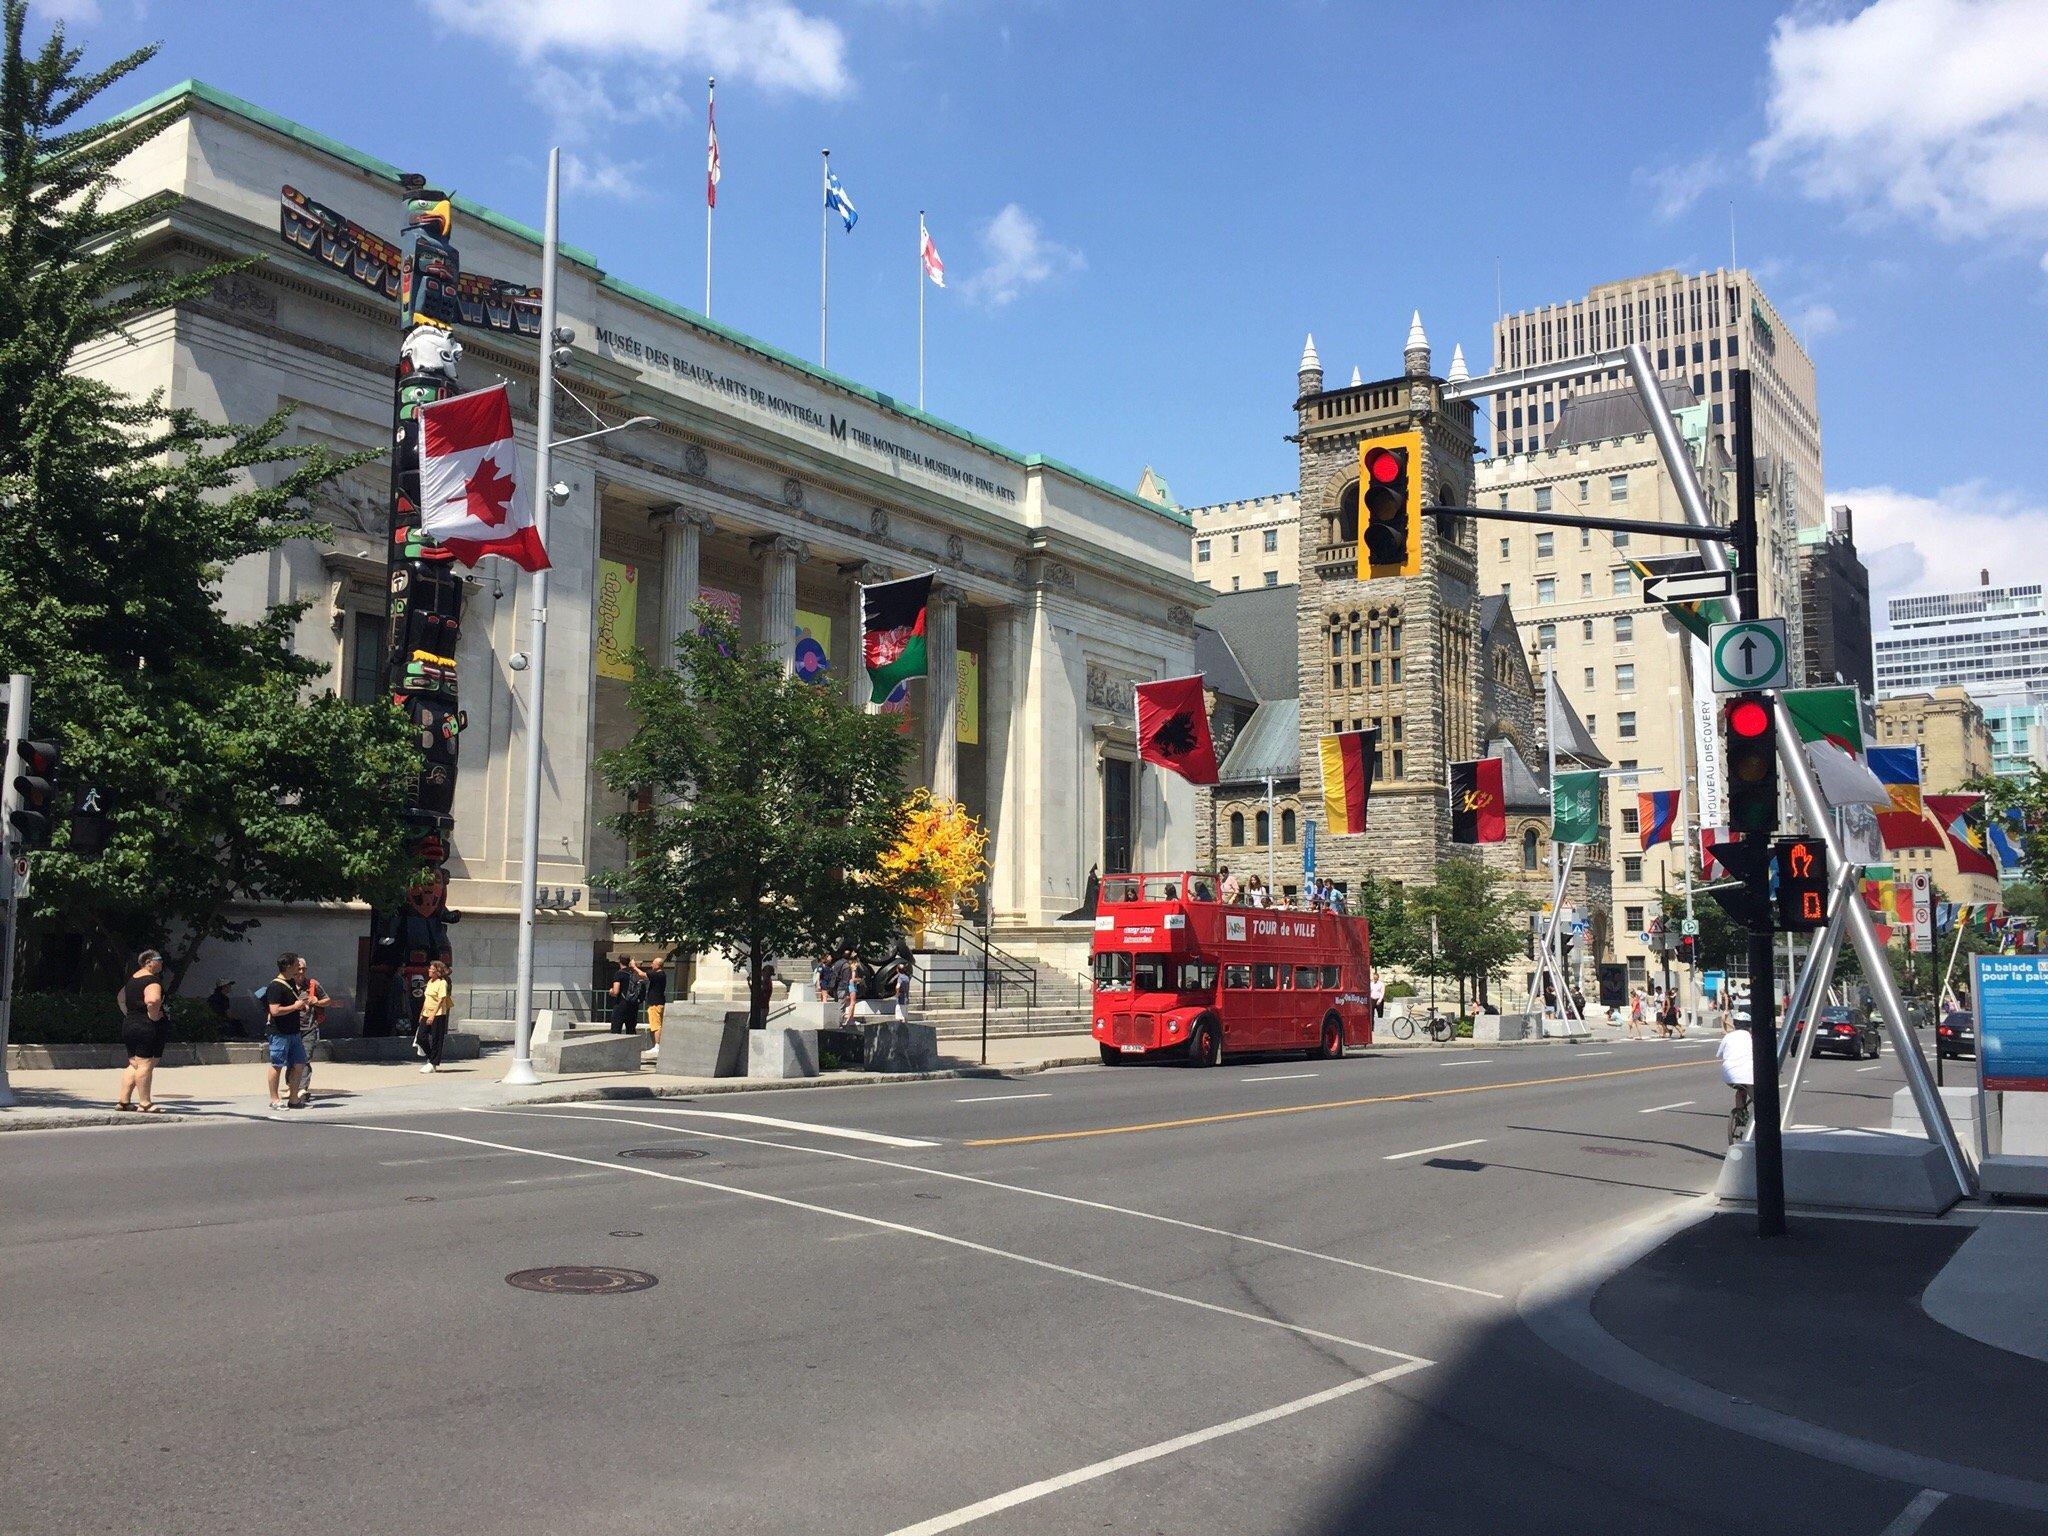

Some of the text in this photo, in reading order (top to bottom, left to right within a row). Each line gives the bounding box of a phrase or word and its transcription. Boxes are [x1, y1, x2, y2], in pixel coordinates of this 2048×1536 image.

[596, 326, 825, 428] MUSÉE DES BEAUX-ARTS DE MONTRÉAL
[830, 414, 846, 441] M
[852, 428, 1016, 502] THE MONTREAL MUSEUM OF FINE ARTS
[1701, 700, 1715, 762] DISCOVERY
[1706, 766, 1718, 818] NOUVEAU
[1252, 920, 1277, 935] TOUR
[1280, 922, 1290, 936] de
[1294, 922, 1316, 938] VILLE
[1982, 963, 1992, 972] la
[1994, 963, 2033, 972] balade
[1982, 973, 2009, 982] pour
[2012, 972, 2022, 981] la
